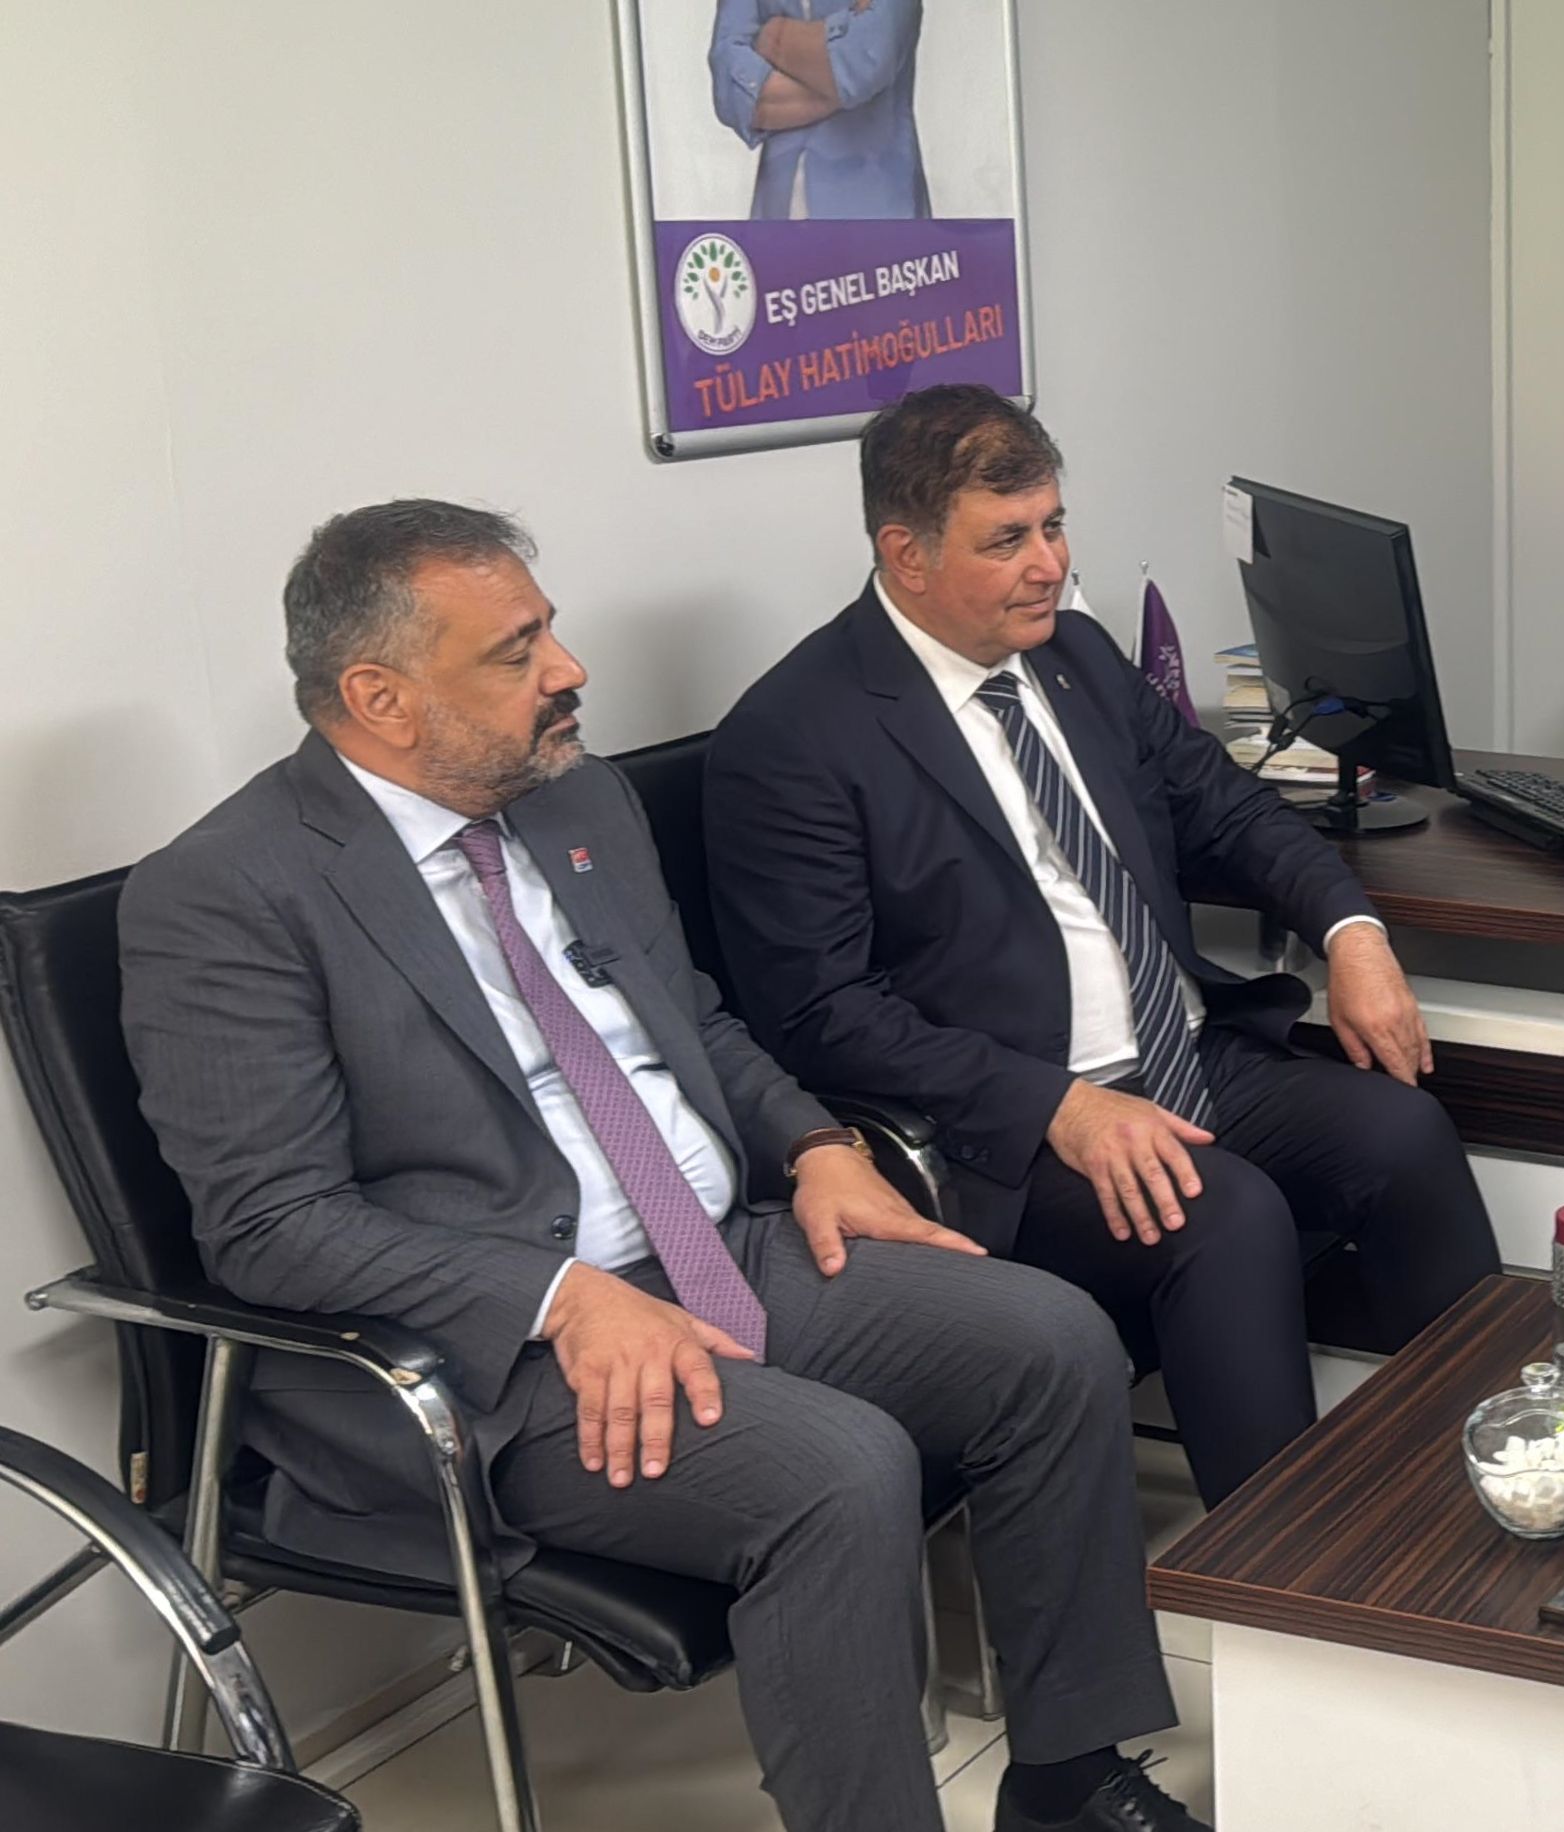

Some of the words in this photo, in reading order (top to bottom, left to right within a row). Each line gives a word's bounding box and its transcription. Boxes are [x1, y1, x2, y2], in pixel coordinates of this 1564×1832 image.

[765, 288, 798, 328] EŞ
[801, 271, 876, 316] GENEL
[875, 250, 961, 297] BAŞKAN
[695, 357, 792, 417] TÜLAY
[799, 304, 1005, 392] HATİMOĞULLARI
